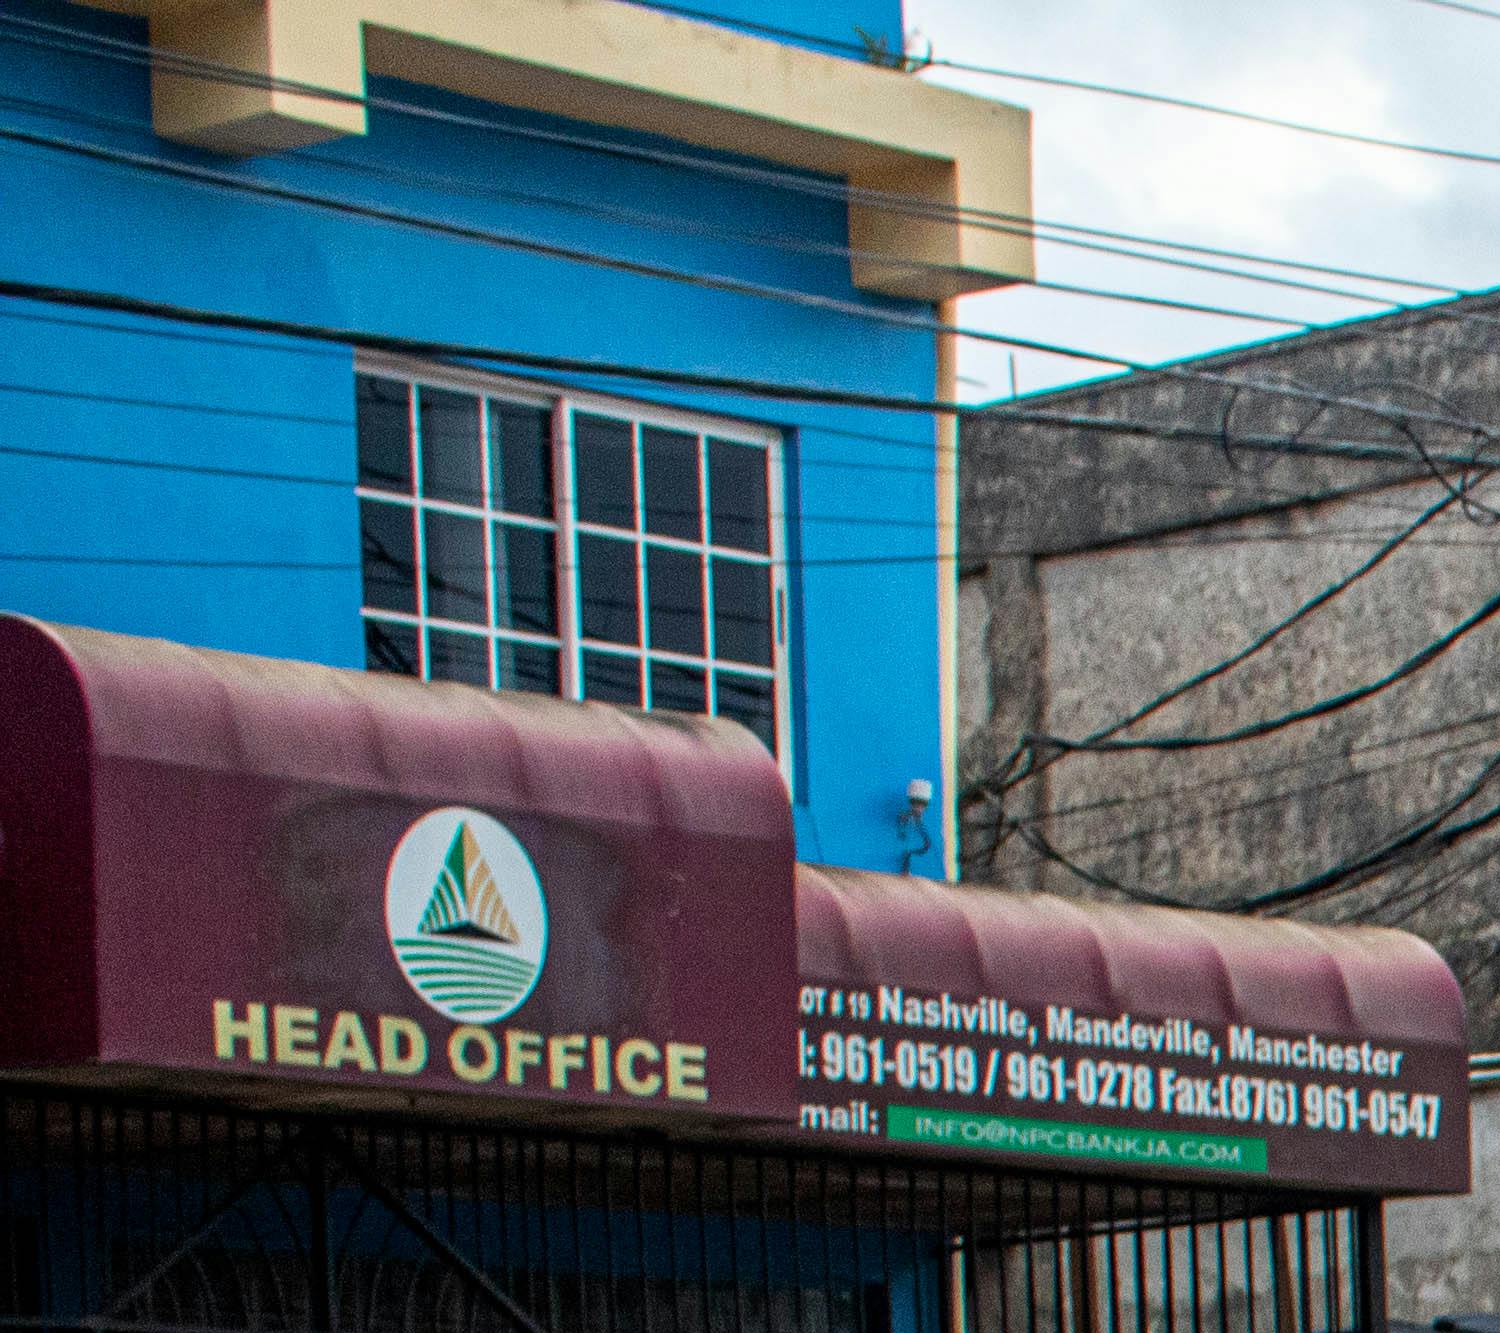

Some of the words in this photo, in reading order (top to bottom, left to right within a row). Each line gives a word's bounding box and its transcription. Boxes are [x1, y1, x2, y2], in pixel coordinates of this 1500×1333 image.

[213, 1000, 428, 1075] HEAD
[447, 1025, 710, 1102] OFFICE
[800, 984, 827, 1015] OT
[877, 984, 1038, 1047] Nashville,
[1046, 1004, 1221, 1065] Mandeville,
[1228, 1024, 1404, 1077] Manchester
[800, 1100, 880, 1135] mail:
[821, 1031, 979, 1095] 961-0519
[1005, 1051, 1155, 1112] 961-0278
[1302, 1084, 1441, 1140] 961-0547
